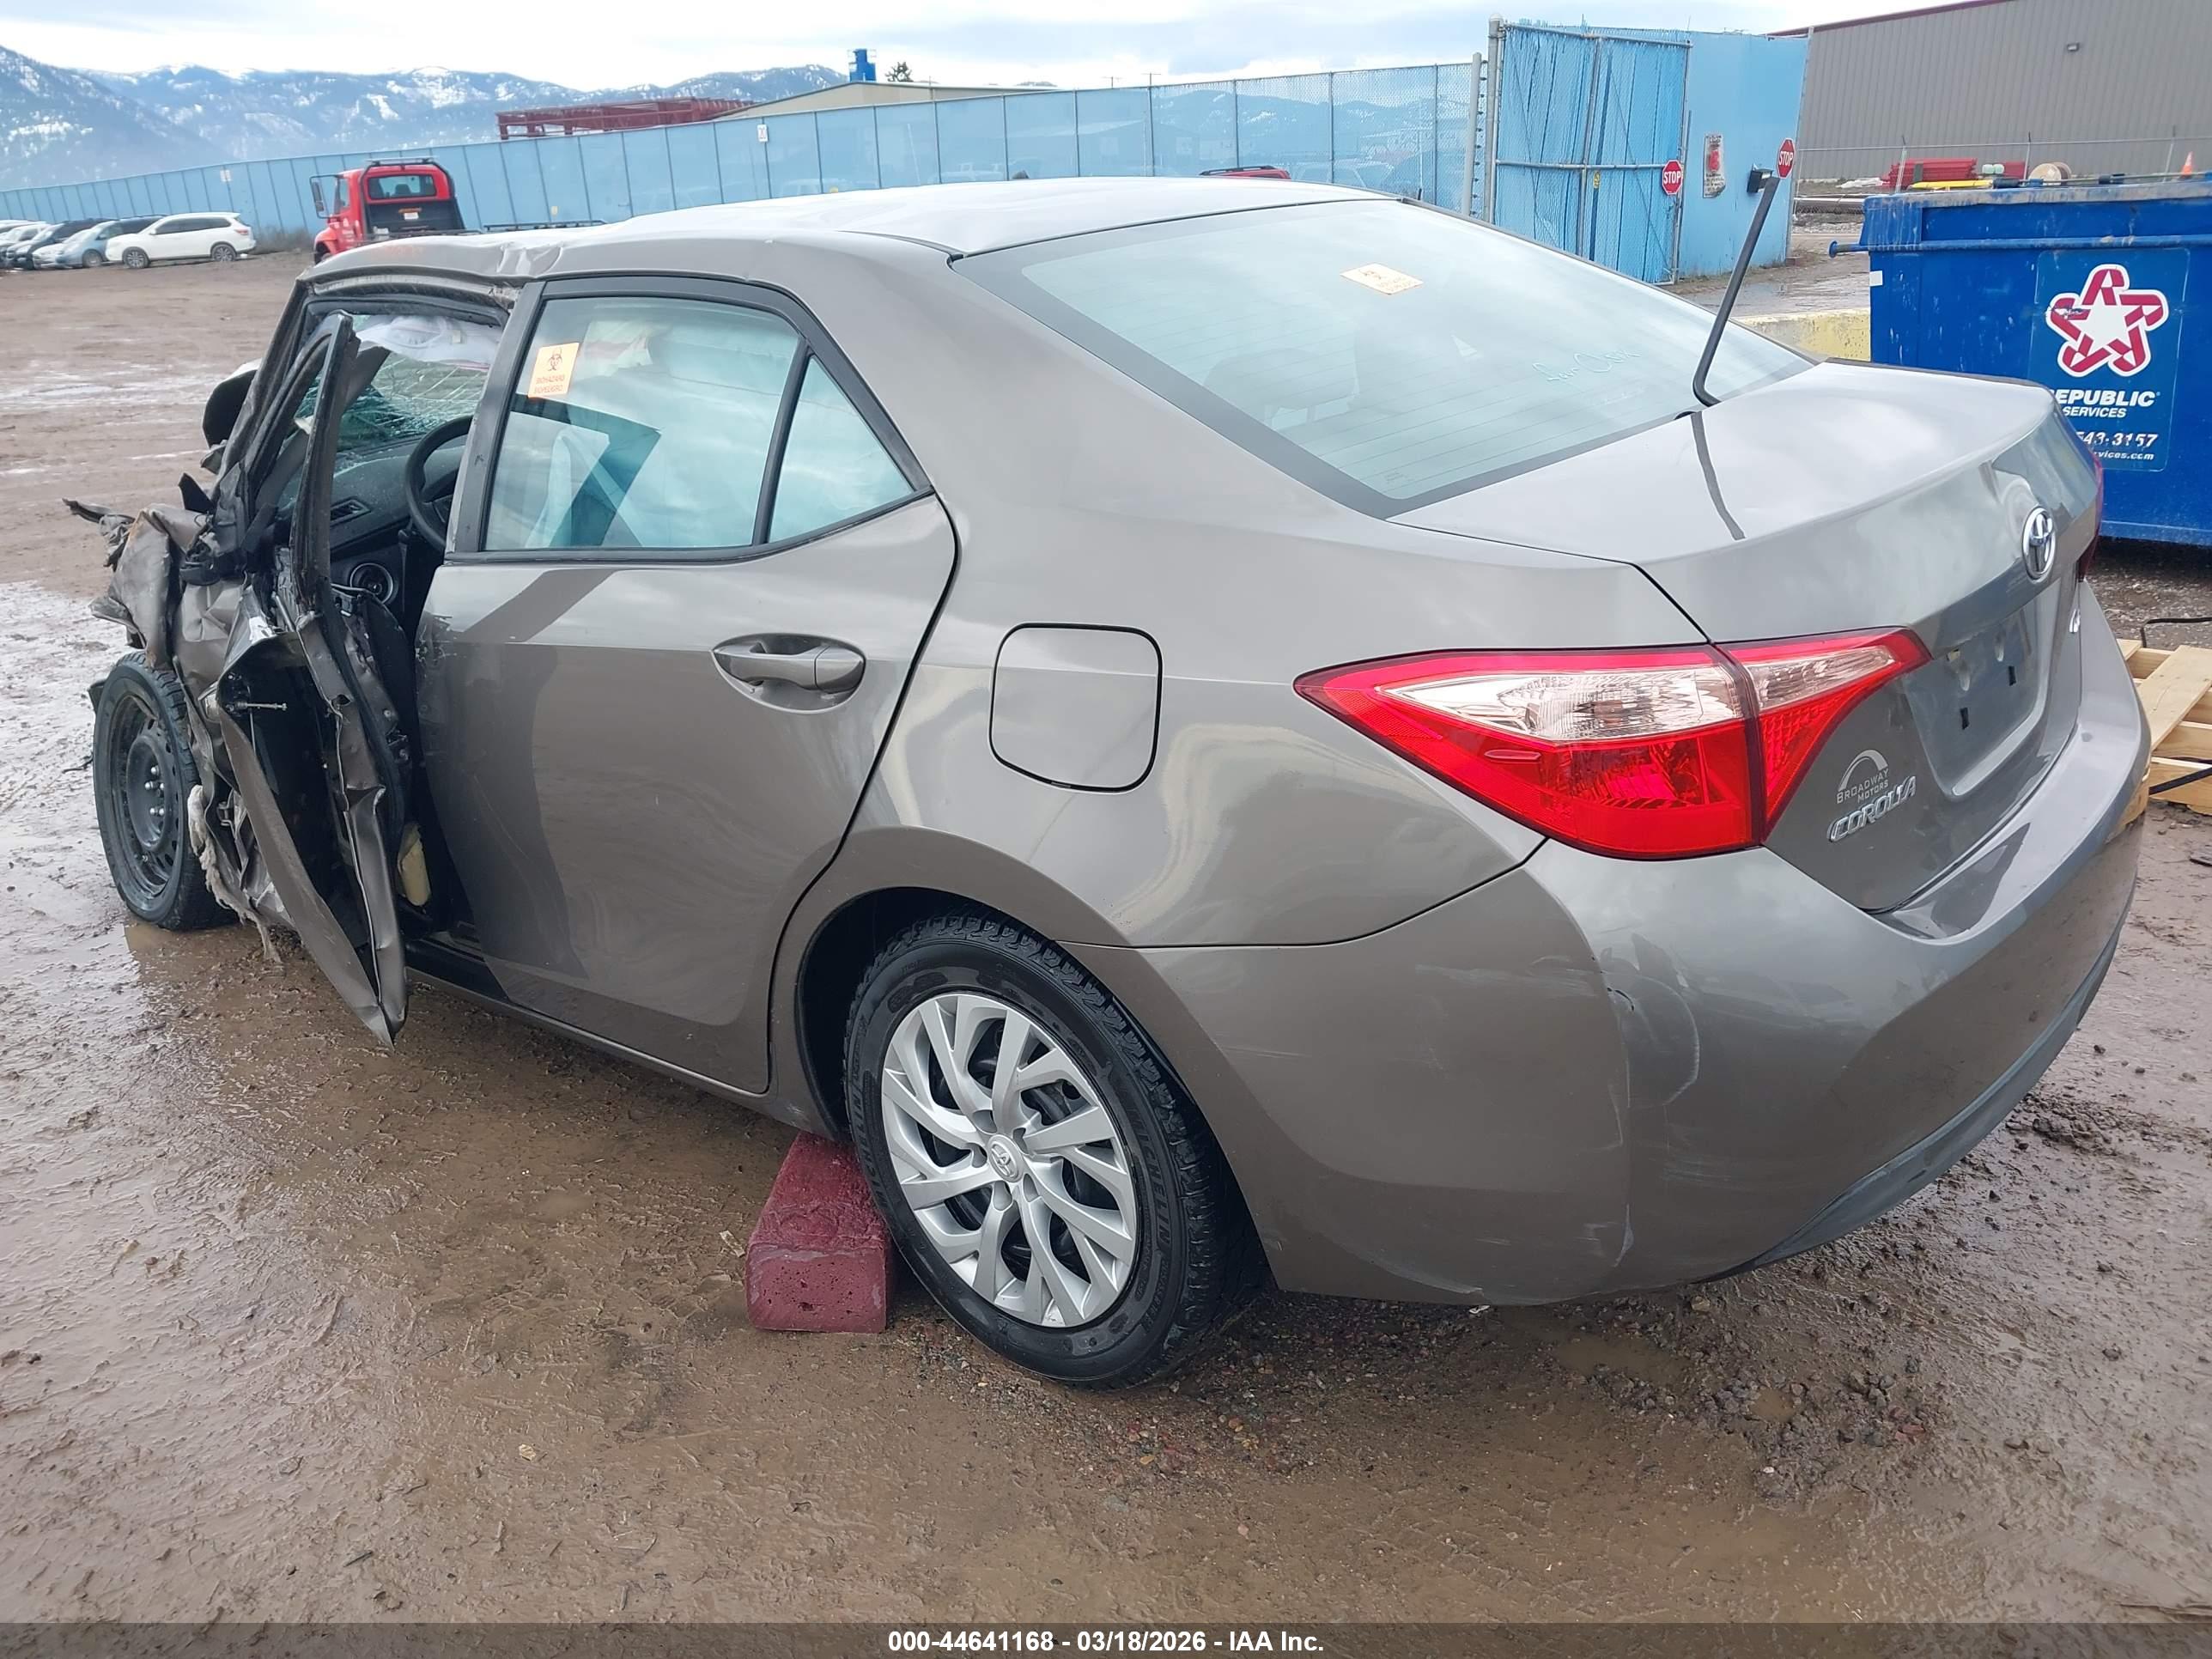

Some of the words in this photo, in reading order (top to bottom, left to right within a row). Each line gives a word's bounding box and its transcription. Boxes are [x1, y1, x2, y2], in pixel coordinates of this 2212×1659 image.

[1778, 151, 1794, 167] STOP
[1663, 171, 1681, 185] STOP
[2062, 406, 2127, 418] SERVICES
[1837, 768, 1889, 805] BROADWAY
[1857, 779, 1889, 804] MOTORS
[1827, 775, 1917, 842] COROLLA
[1128, 1106, 1171, 1244] MICHELIN
